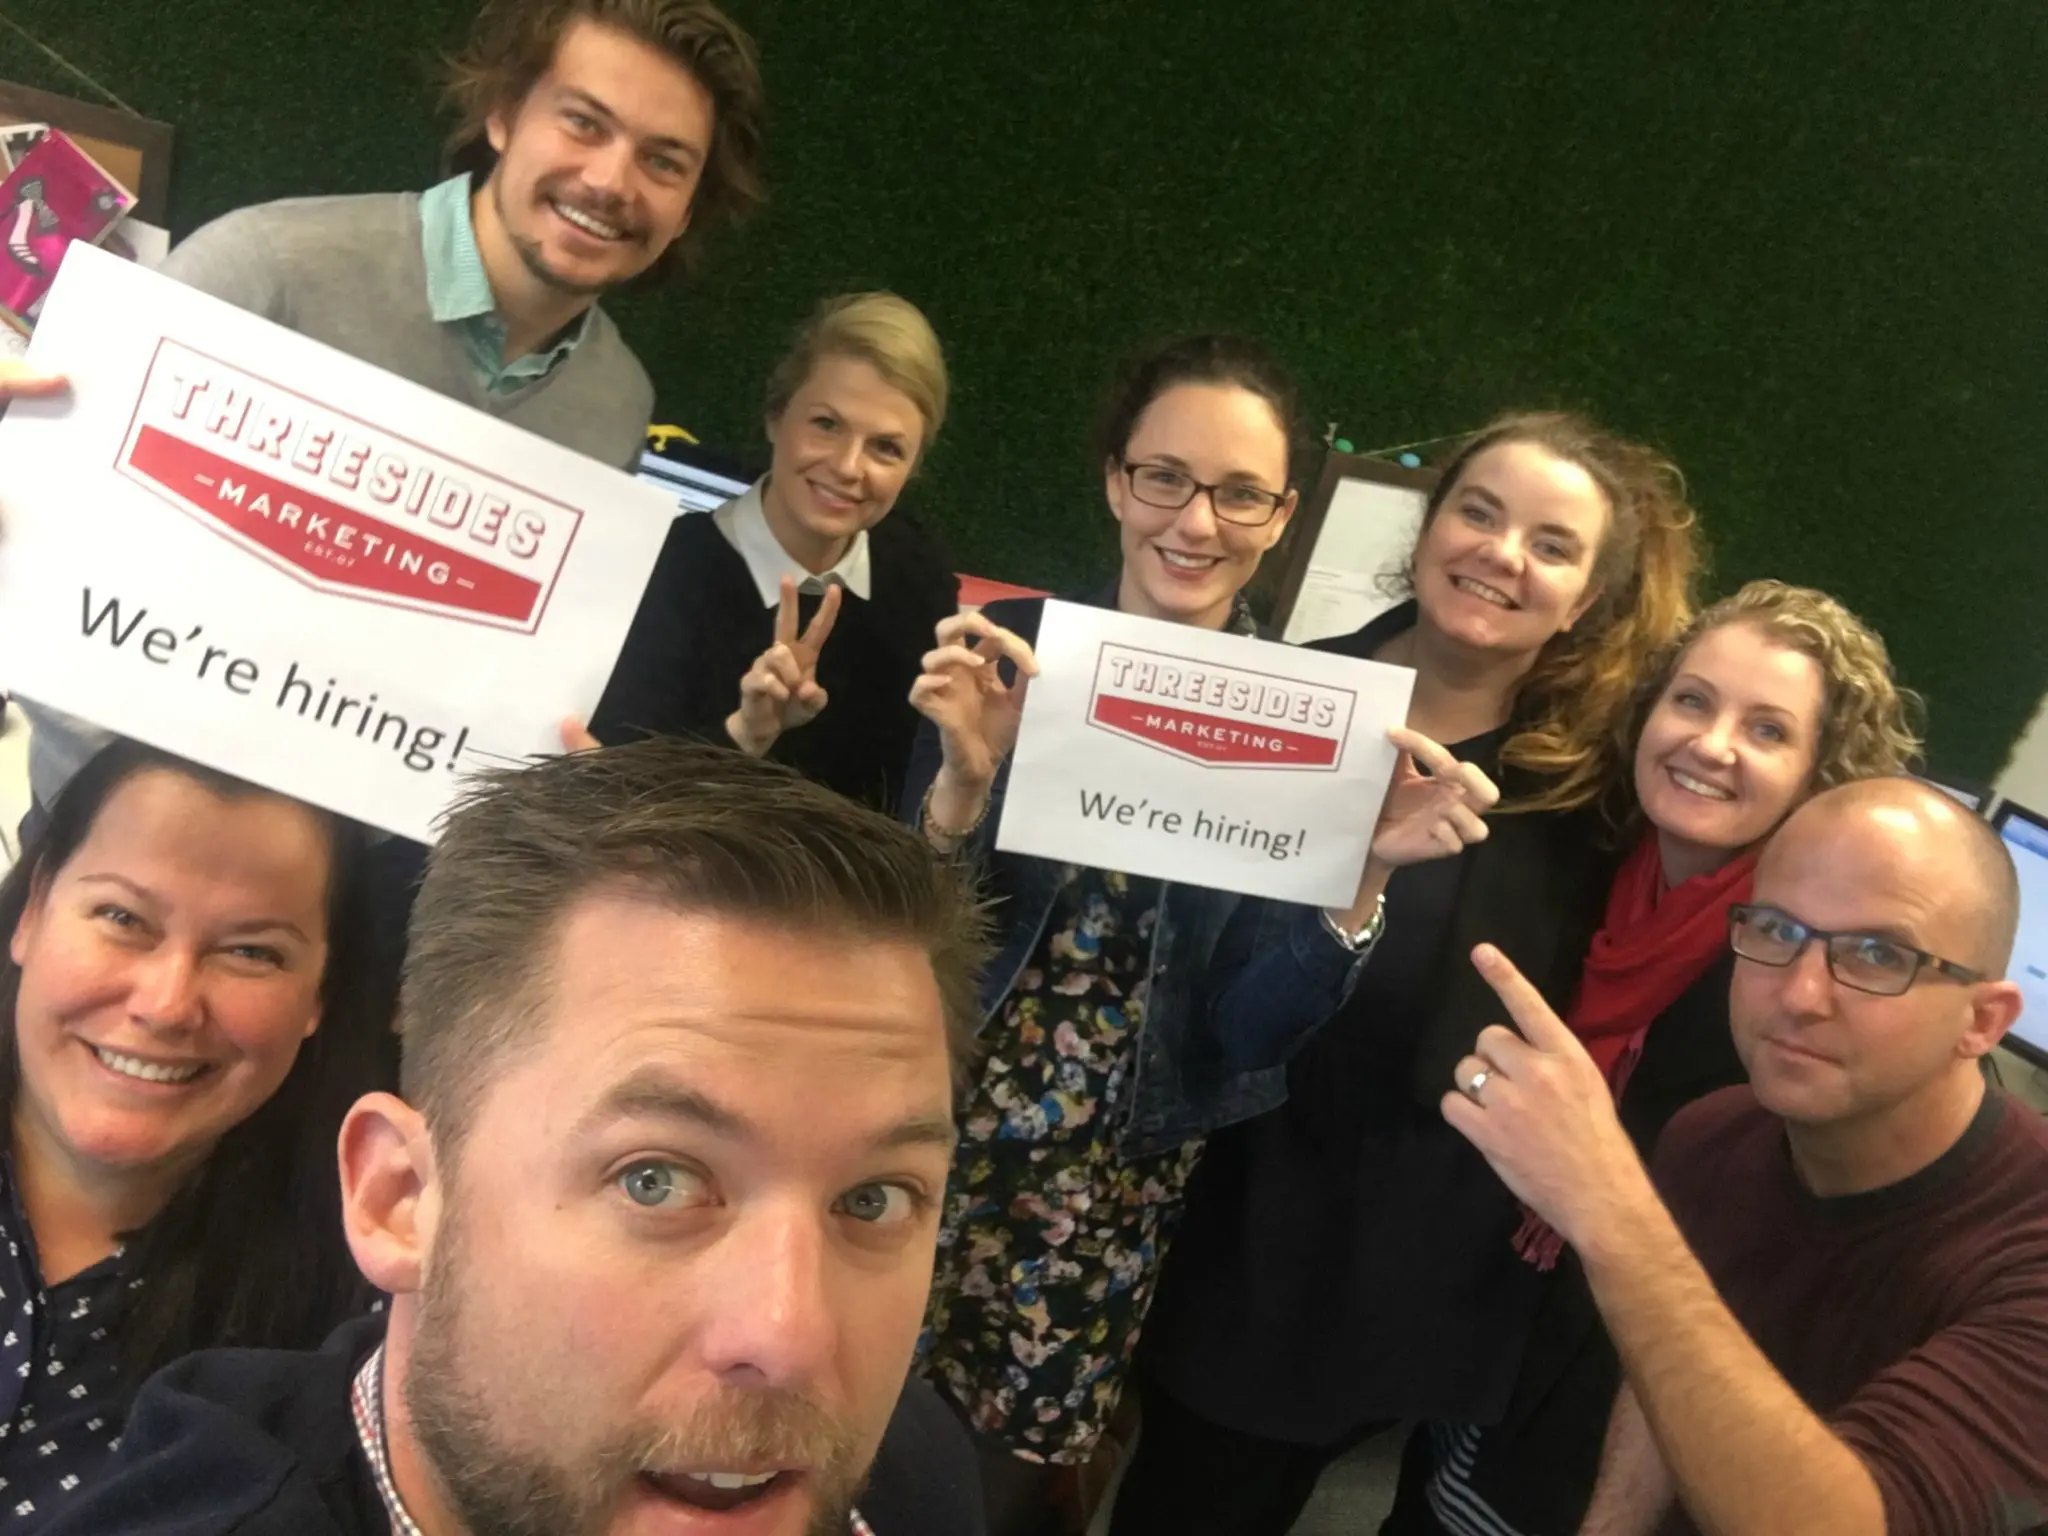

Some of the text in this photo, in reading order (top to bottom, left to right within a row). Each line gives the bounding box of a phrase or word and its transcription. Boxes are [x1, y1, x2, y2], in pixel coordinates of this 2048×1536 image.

[173, 374, 547, 560] THREESIDES
[218, 476, 449, 585] MARKETING
[81, 585, 471, 773] We're hiring!
[1111, 656, 1336, 728] THREESIDES
[1146, 714, 1283, 752] MARKETING
[1080, 789, 1307, 861] We're hiring!
